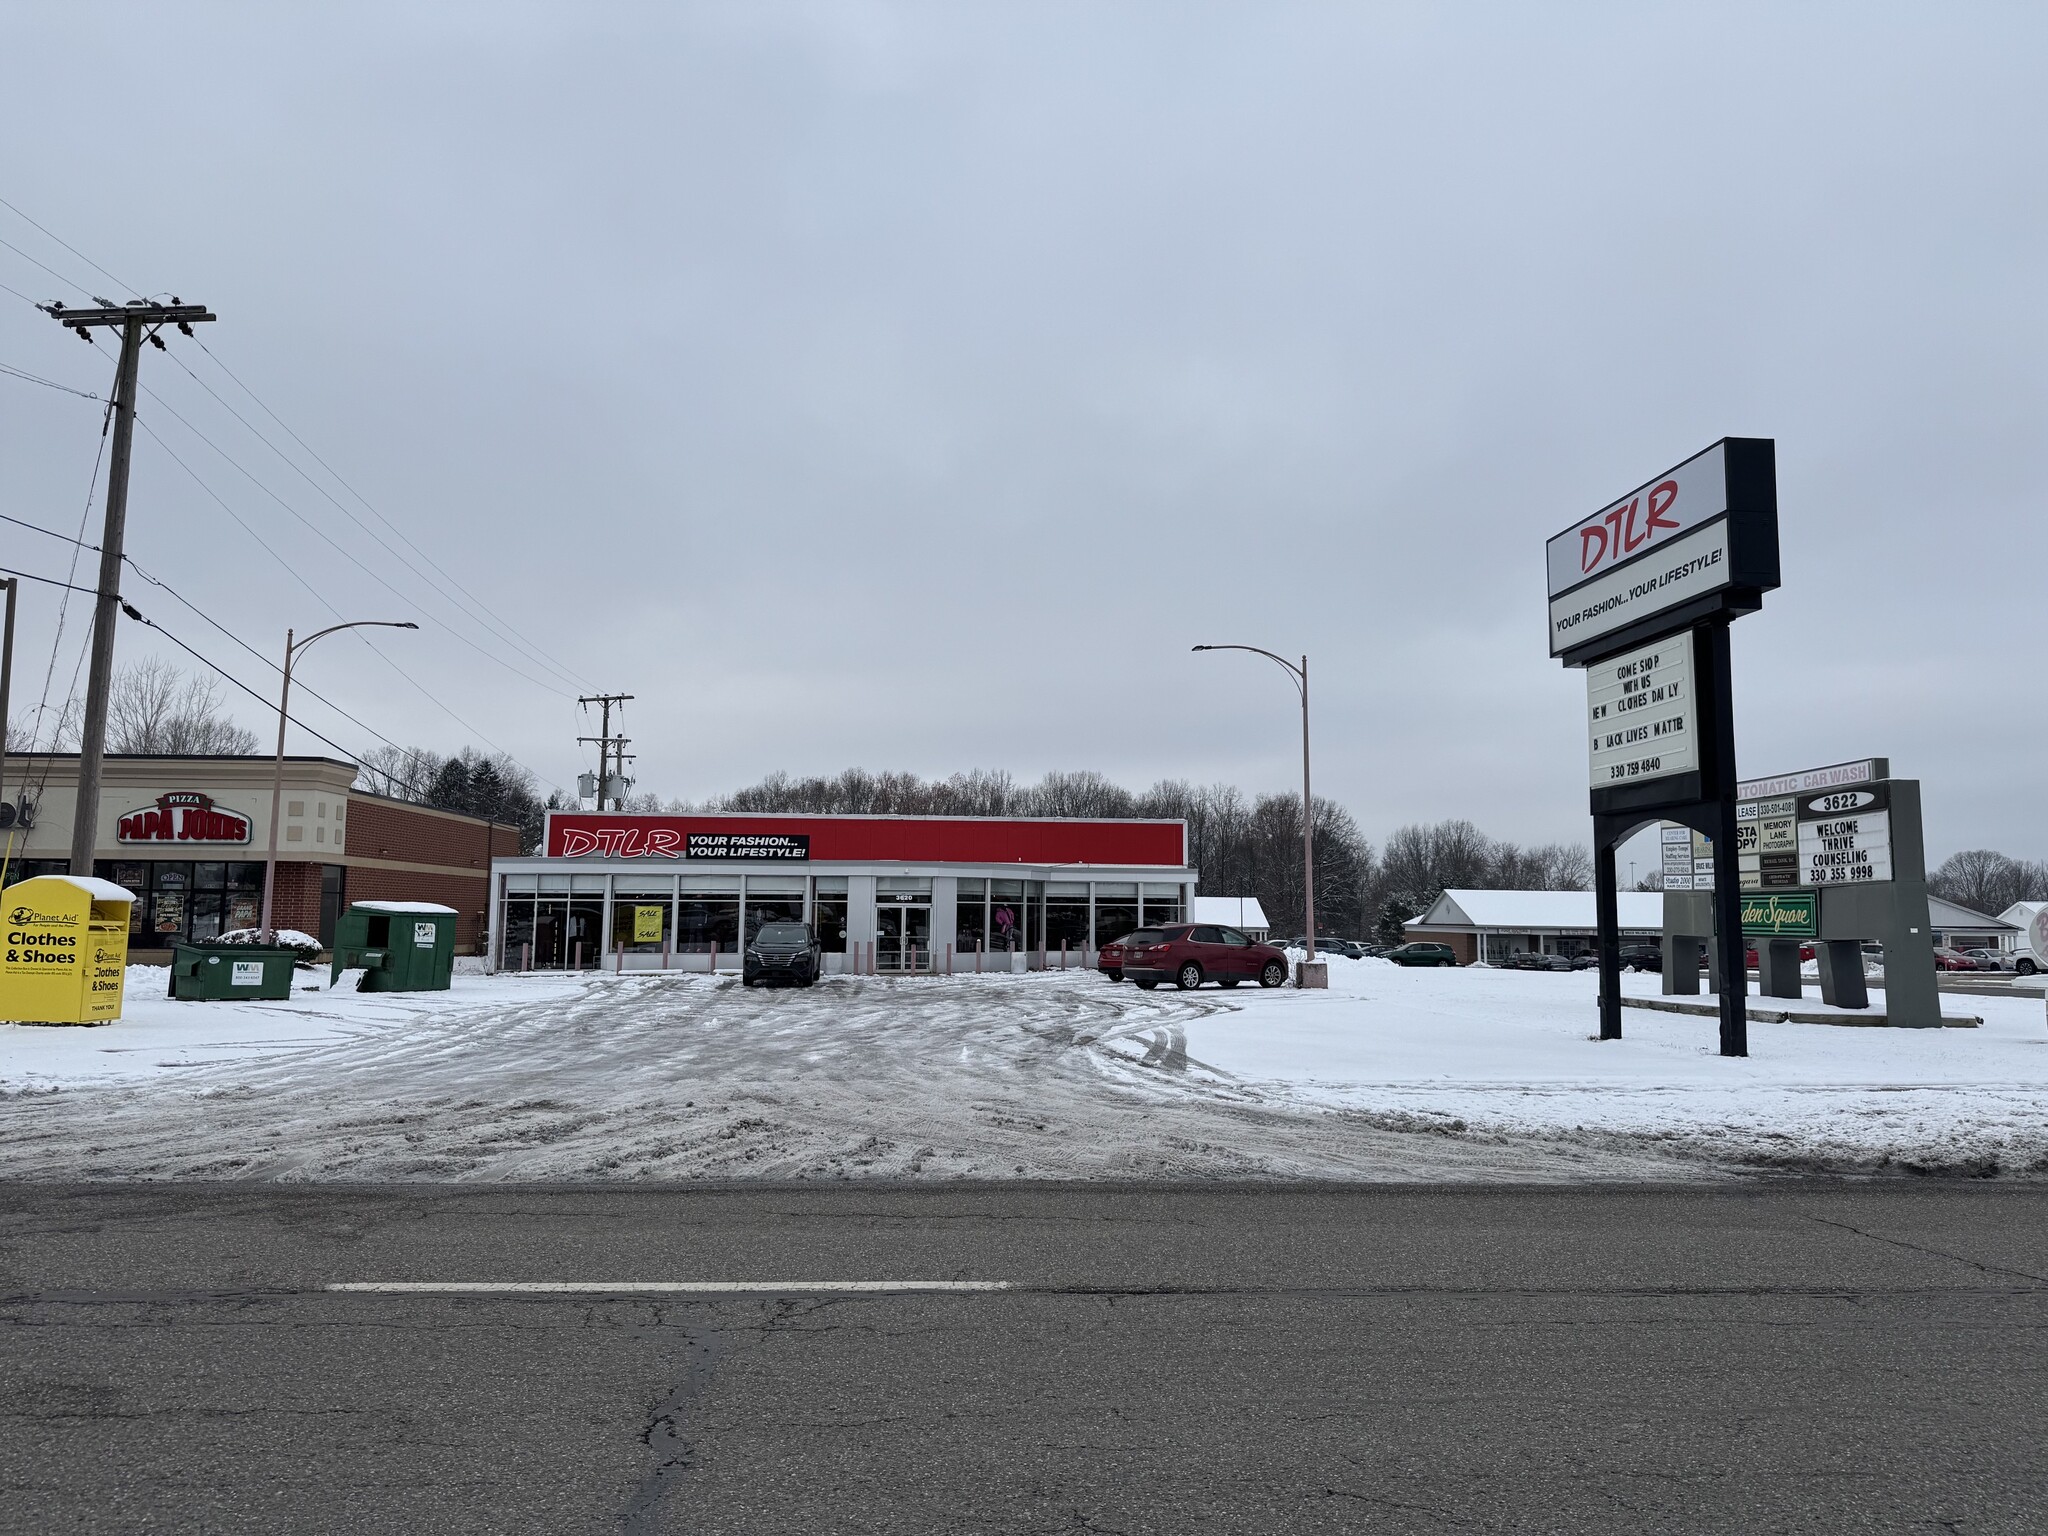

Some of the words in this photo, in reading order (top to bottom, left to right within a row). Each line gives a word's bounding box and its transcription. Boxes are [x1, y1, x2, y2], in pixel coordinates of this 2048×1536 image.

[1580, 480, 1681, 574] DTLR
[1556, 612, 1581, 632] YOUR
[1658, 548, 1723, 588] LIFESTYLE!
[1617, 662, 1637, 680] COME
[1641, 675, 1651, 689] US
[1626, 726, 1648, 743] LIVES
[1610, 765, 1624, 779] 330
[1626, 762, 1639, 776] 759
[1641, 757, 1661, 772] 4840
[1737, 778, 1797, 798] TOMATIC
[1803, 772, 1827, 788] CAR
[1829, 765, 1867, 783] WASH
[169, 795, 200, 804] PIZZA
[1823, 793, 1858, 811] 3622
[1738, 806, 1757, 818] LEASE
[1760, 801, 1795, 815] 330-501-4081
[119, 809, 174, 840] PAPA
[1763, 820, 1792, 831] MEMORY
[1816, 820, 1859, 837] WELCOME
[1737, 826, 1757, 838] STA
[1769, 830, 1787, 840] LANE
[563, 828, 681, 859] DTLR
[689, 836, 728, 847] YOUR
[730, 836, 799, 847] FASHION...
[1737, 837, 1758, 850] OPY
[1762, 839, 1795, 850] PHOTOGRAPHY
[1822, 836, 1855, 851] THRIVE
[689, 847, 728, 857] YOUR
[729, 847, 806, 858] LIFESTYLE!
[1812, 850, 1868, 867] COUNSELING
[162, 873, 184, 881] OPEN
[1810, 869, 1826, 882] 330
[1830, 867, 1846, 880] 355
[1850, 865, 1873, 880] 9998
[34, 912, 59, 921] Planet
[638, 910, 660, 918] SALE
[1741, 901, 1763, 923] den
[1763, 896, 1810, 933] Square
[7, 931, 76, 946] Clothes
[637, 930, 660, 938] SALE
[6, 949, 20, 963] &
[23, 949, 76, 964] Shoes
[92, 980, 98, 992] &
[98, 980, 119, 991] Shoes
